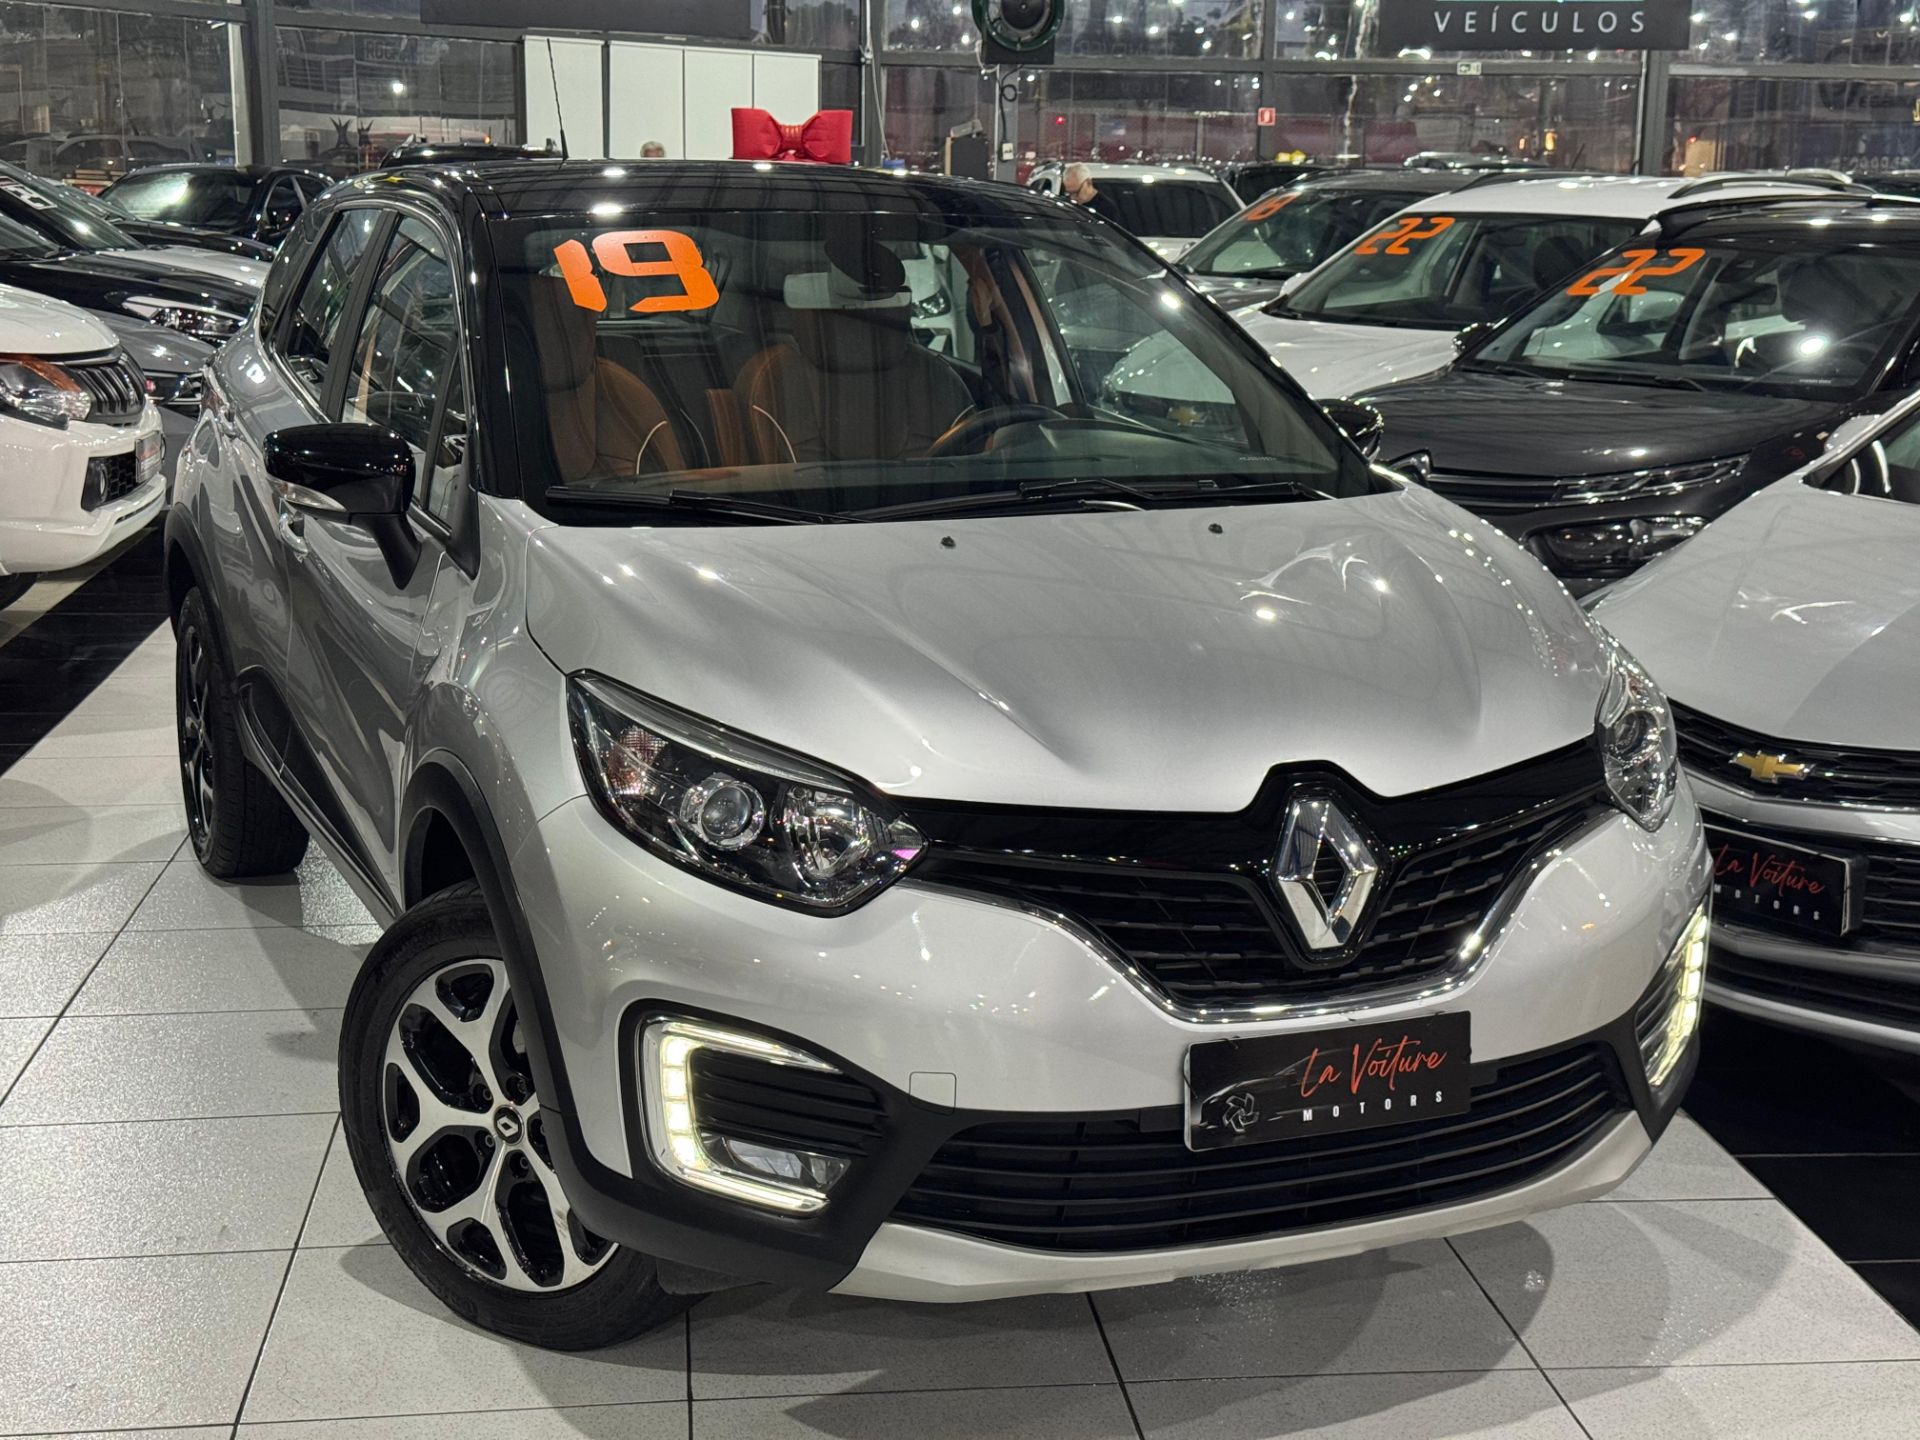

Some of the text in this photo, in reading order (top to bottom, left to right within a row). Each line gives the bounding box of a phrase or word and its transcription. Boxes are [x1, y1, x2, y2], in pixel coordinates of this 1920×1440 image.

[1434, 6, 1645, 33] VEÍCULOS
[1354, 216, 1456, 255] 22
[553, 230, 720, 313] 19
[1566, 247, 1706, 296] 22
[1749, 852, 1825, 897] Voiture
[1713, 883, 1820, 921] MOTORS
[1300, 1034, 1448, 1098] La Voiture
[1303, 1090, 1443, 1122] MOTORS
